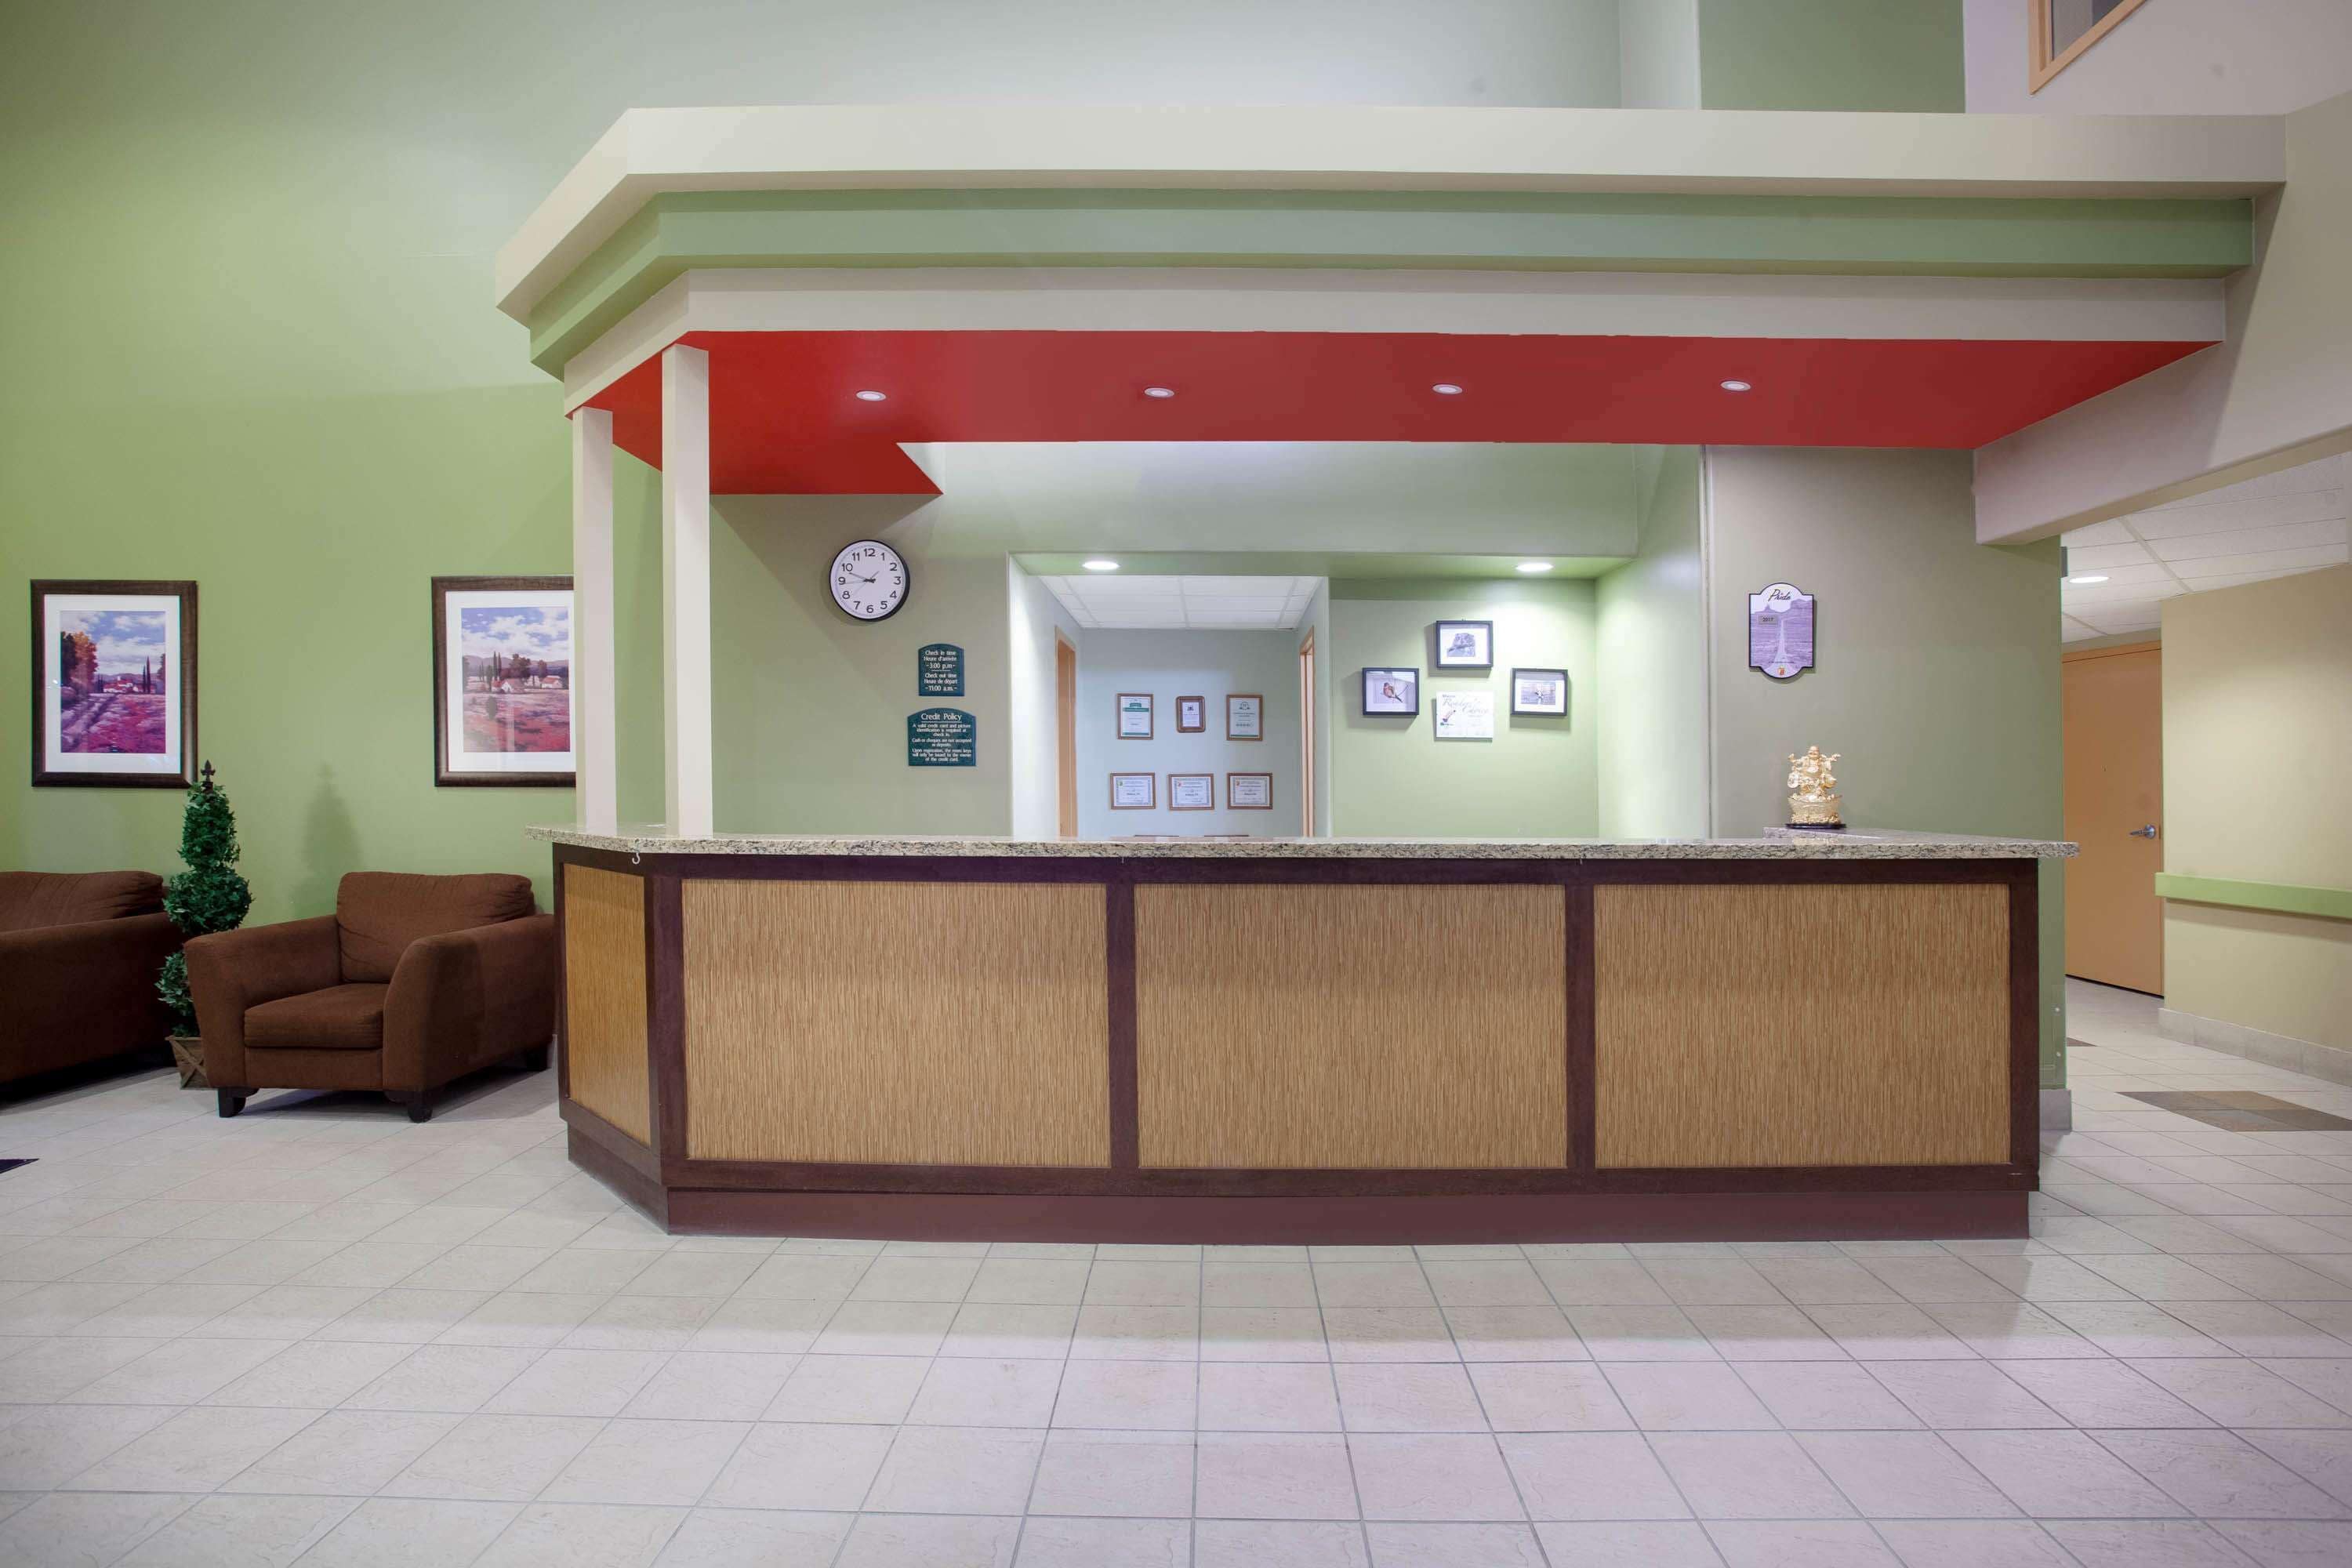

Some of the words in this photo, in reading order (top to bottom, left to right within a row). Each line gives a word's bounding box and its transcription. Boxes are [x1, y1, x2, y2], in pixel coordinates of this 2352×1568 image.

[851, 553, 860, 561] 11
[863, 548, 876, 557] 12
[841, 563, 853, 572] 10
[894, 576, 902, 585] 3
[842, 590, 851, 600] 8
[889, 590, 897, 599] 4
[853, 601, 861, 610] 7
[866, 604, 874, 613] 6
[880, 601, 887, 610] 5
[943, 713, 962, 721] Policy
